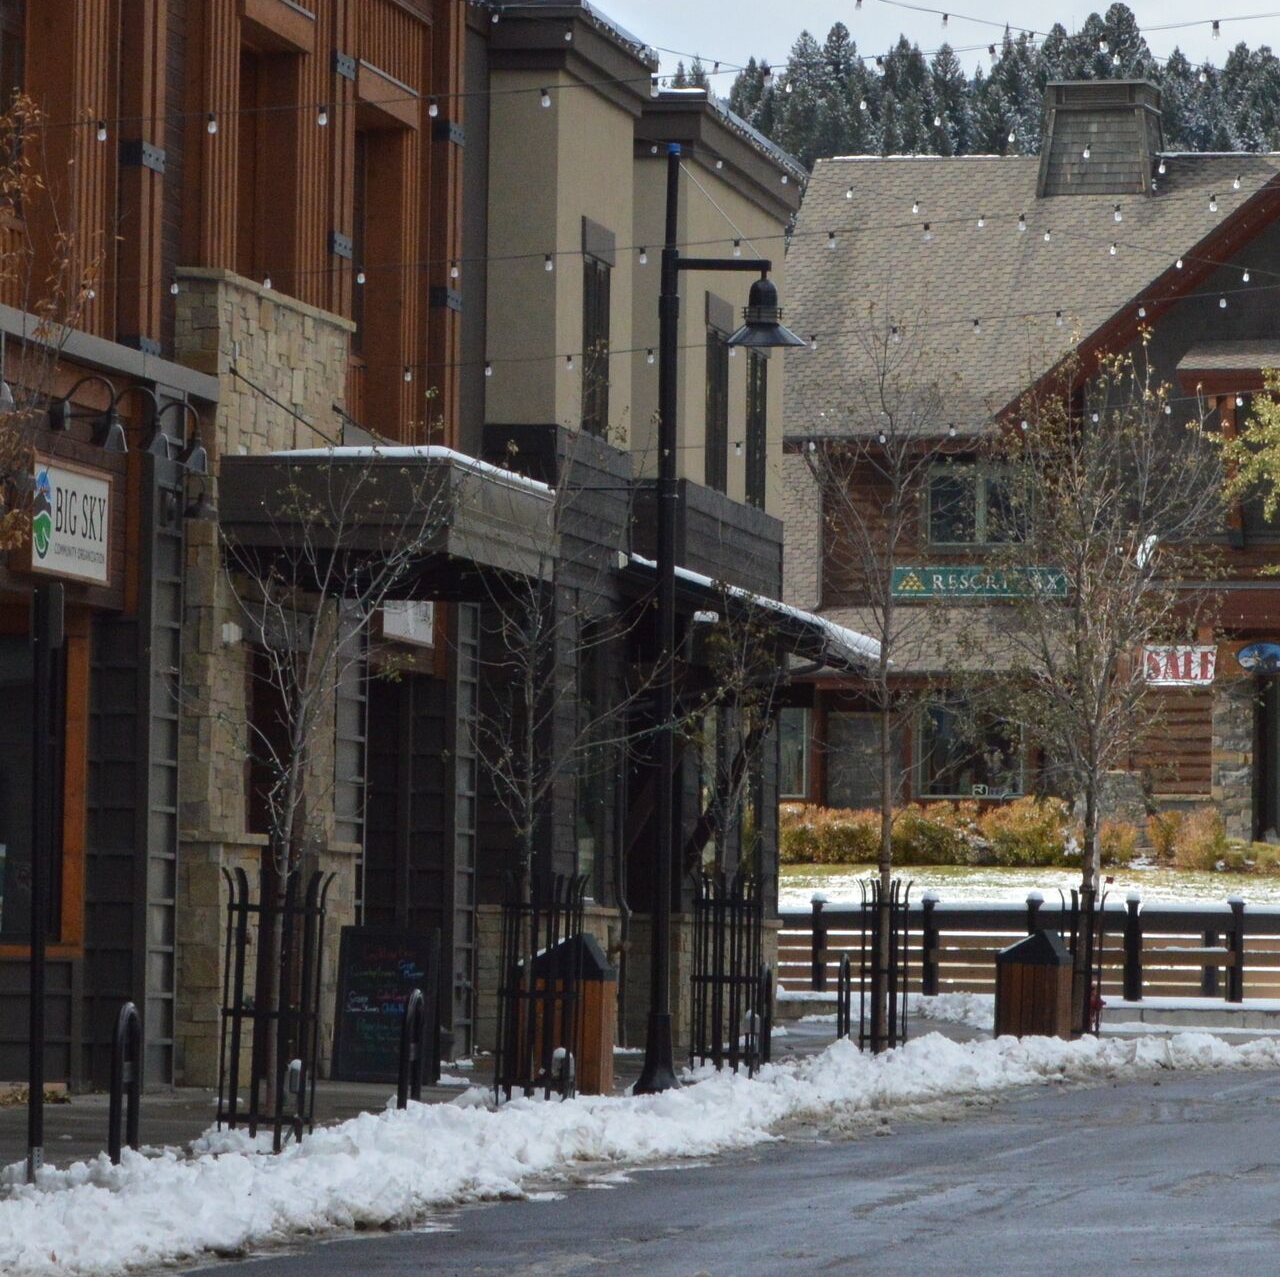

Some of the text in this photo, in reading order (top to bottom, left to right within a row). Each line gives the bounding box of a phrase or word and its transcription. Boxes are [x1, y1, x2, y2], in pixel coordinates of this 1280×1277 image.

[55, 486, 106, 543] BIG SKY
[1146, 650, 1216, 680] SALE
